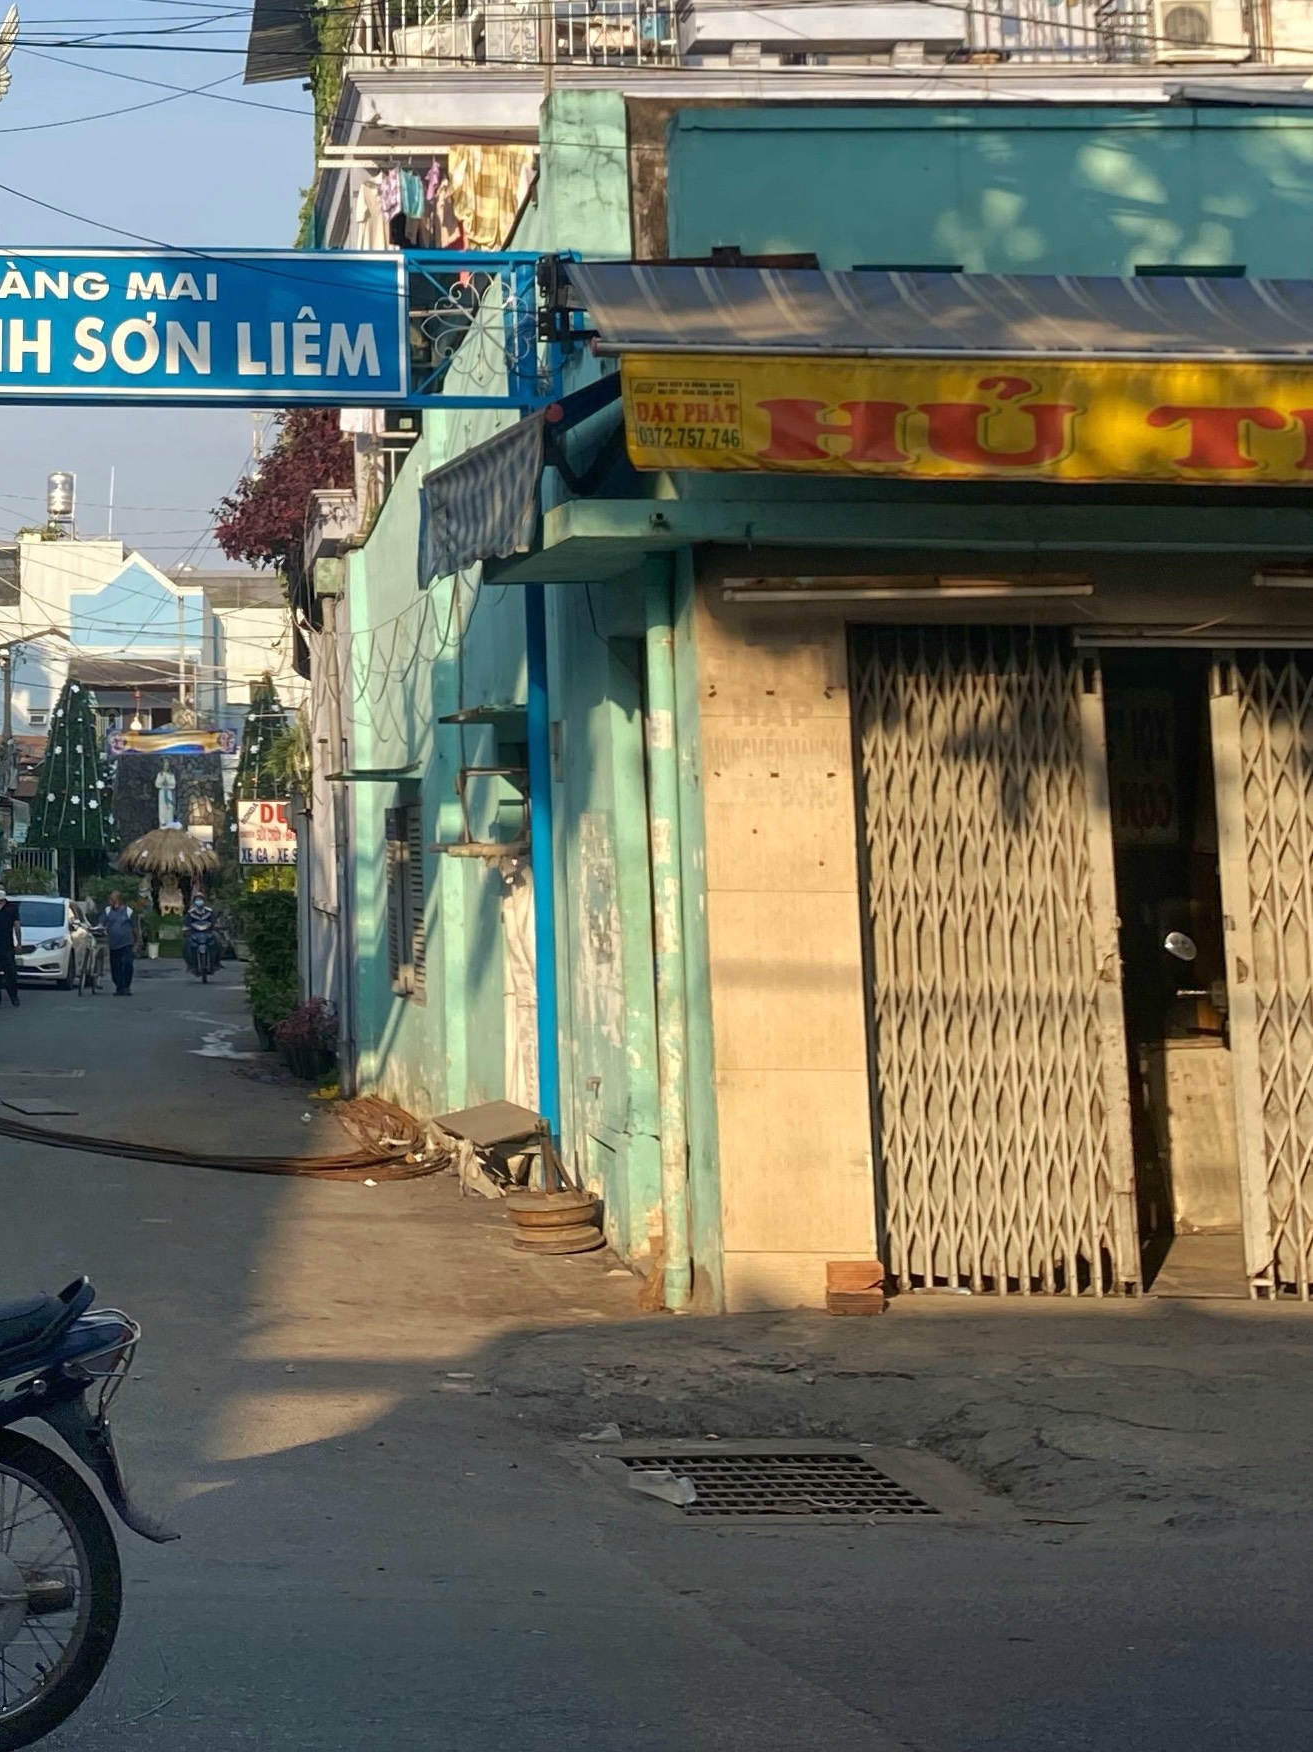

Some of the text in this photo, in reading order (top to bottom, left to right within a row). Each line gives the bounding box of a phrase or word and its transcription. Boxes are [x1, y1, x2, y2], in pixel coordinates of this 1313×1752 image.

[126, 271, 218, 301] MAI
[72, 311, 211, 376] SƠN
[237, 306, 382, 377] LIÊM
[635, 398, 739, 426] ĐẠT PHÁT
[639, 427, 741, 449] 0372.757.746
[241, 847, 254, 863] XE
